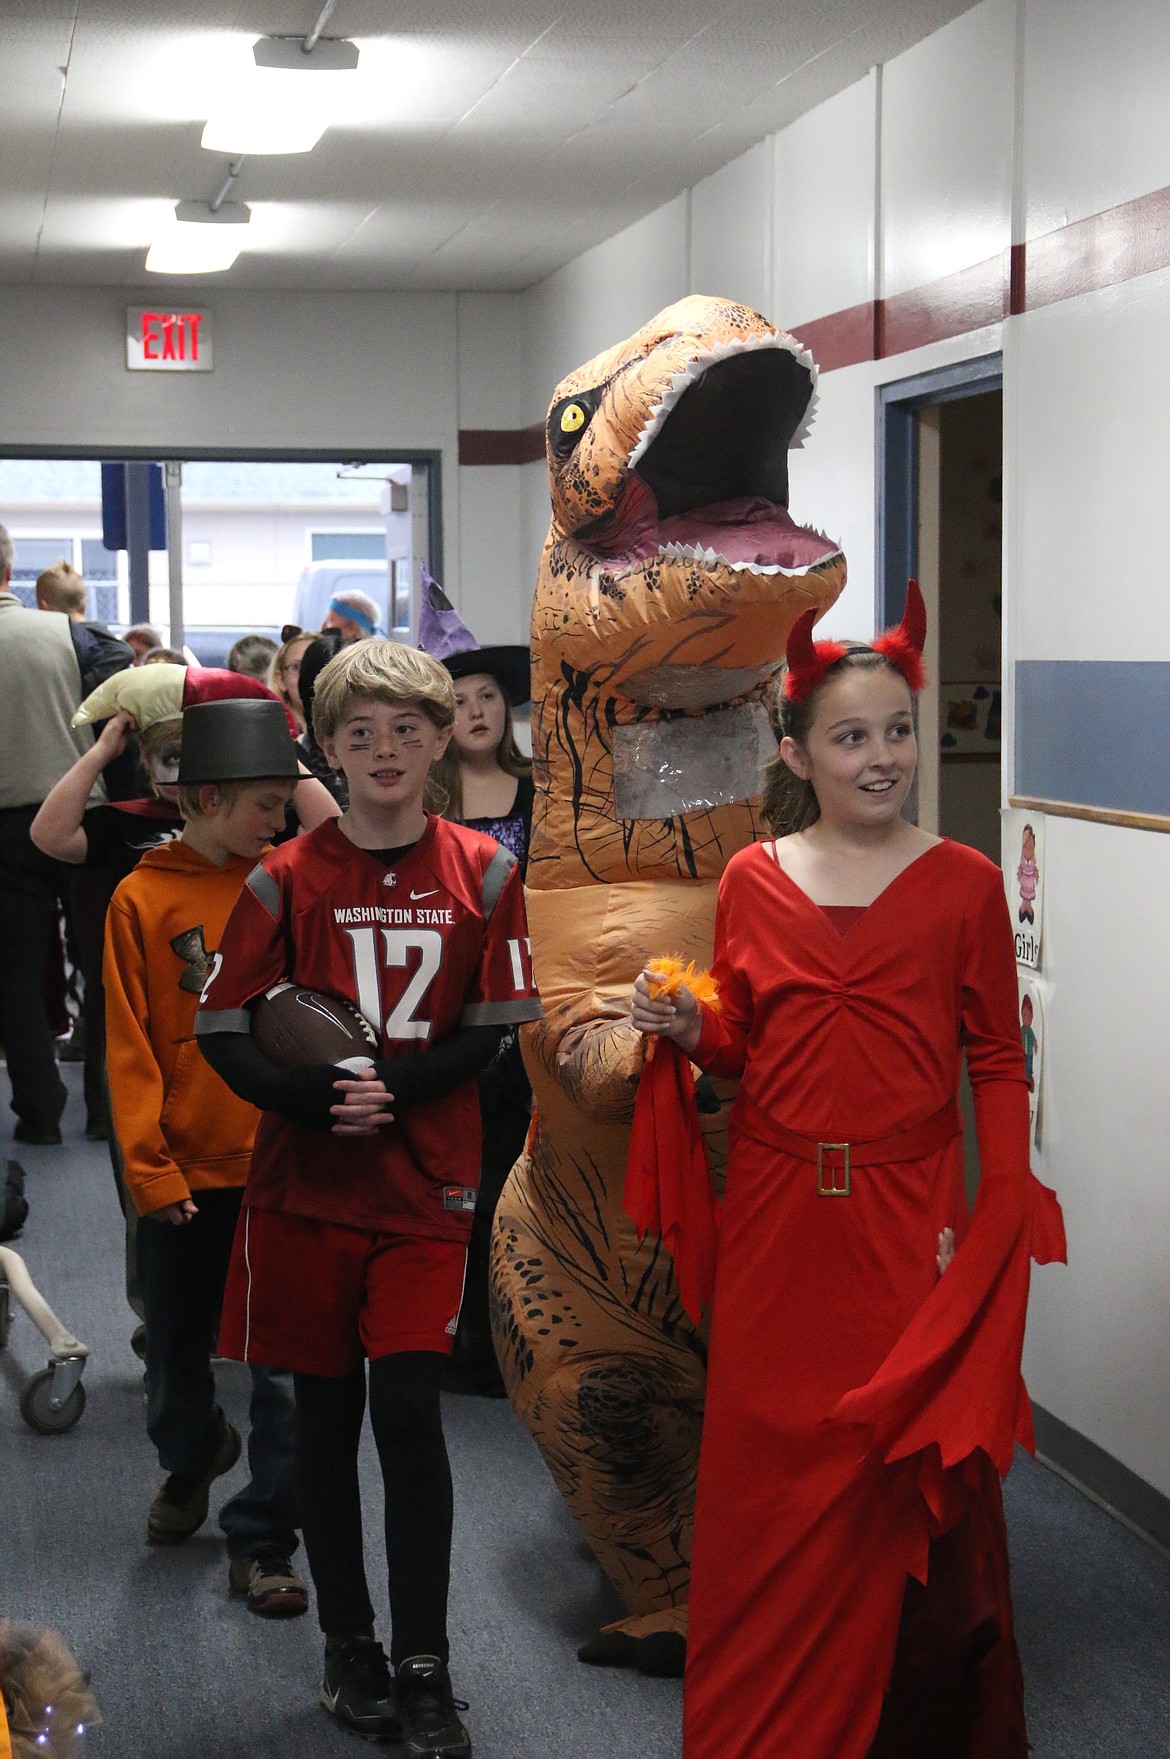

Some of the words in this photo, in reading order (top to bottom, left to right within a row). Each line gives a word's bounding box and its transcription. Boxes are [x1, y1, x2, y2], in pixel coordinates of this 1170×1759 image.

[142, 312, 203, 361] EXIT
[333, 906, 413, 924] WASHINGTON
[344, 925, 444, 1041] 12
